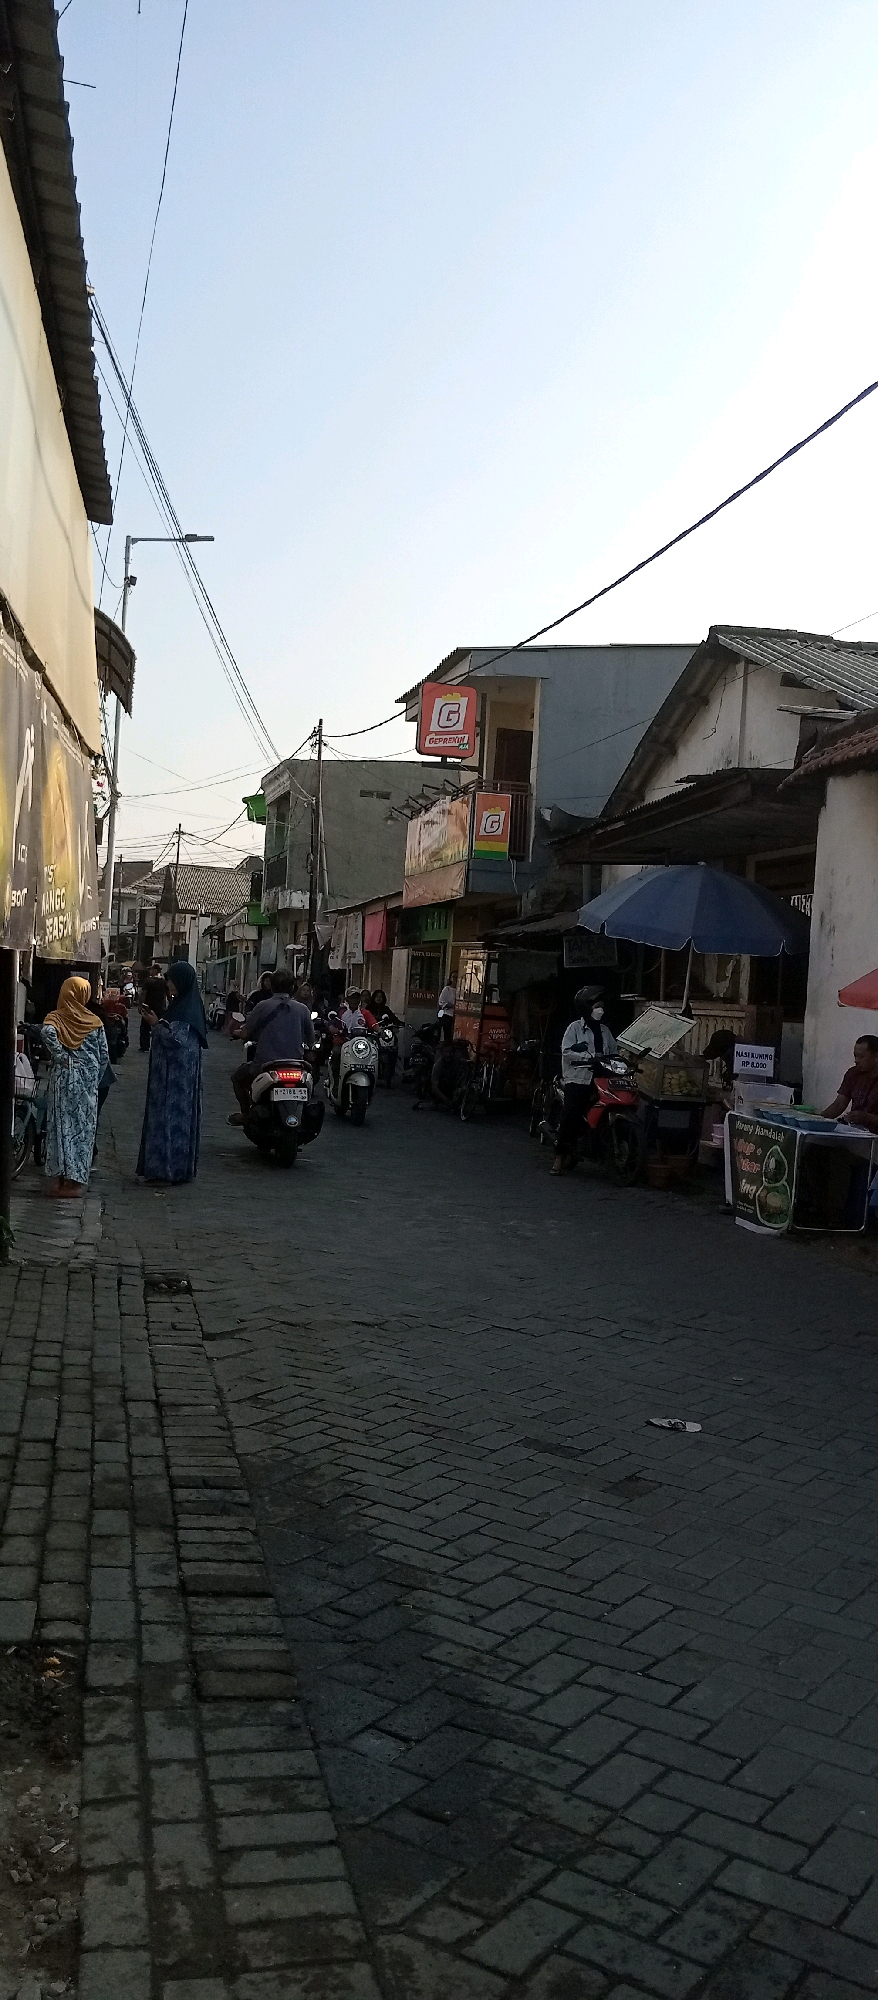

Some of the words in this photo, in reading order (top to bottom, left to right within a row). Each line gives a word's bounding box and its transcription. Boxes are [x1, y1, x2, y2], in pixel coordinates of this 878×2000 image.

[437, 702, 461, 729] G
[484, 813, 501, 834] G
[736, 1050, 750, 1058] NASI
[751, 1052, 773, 1061] KUNING
[742, 1060, 751, 1068] RP
